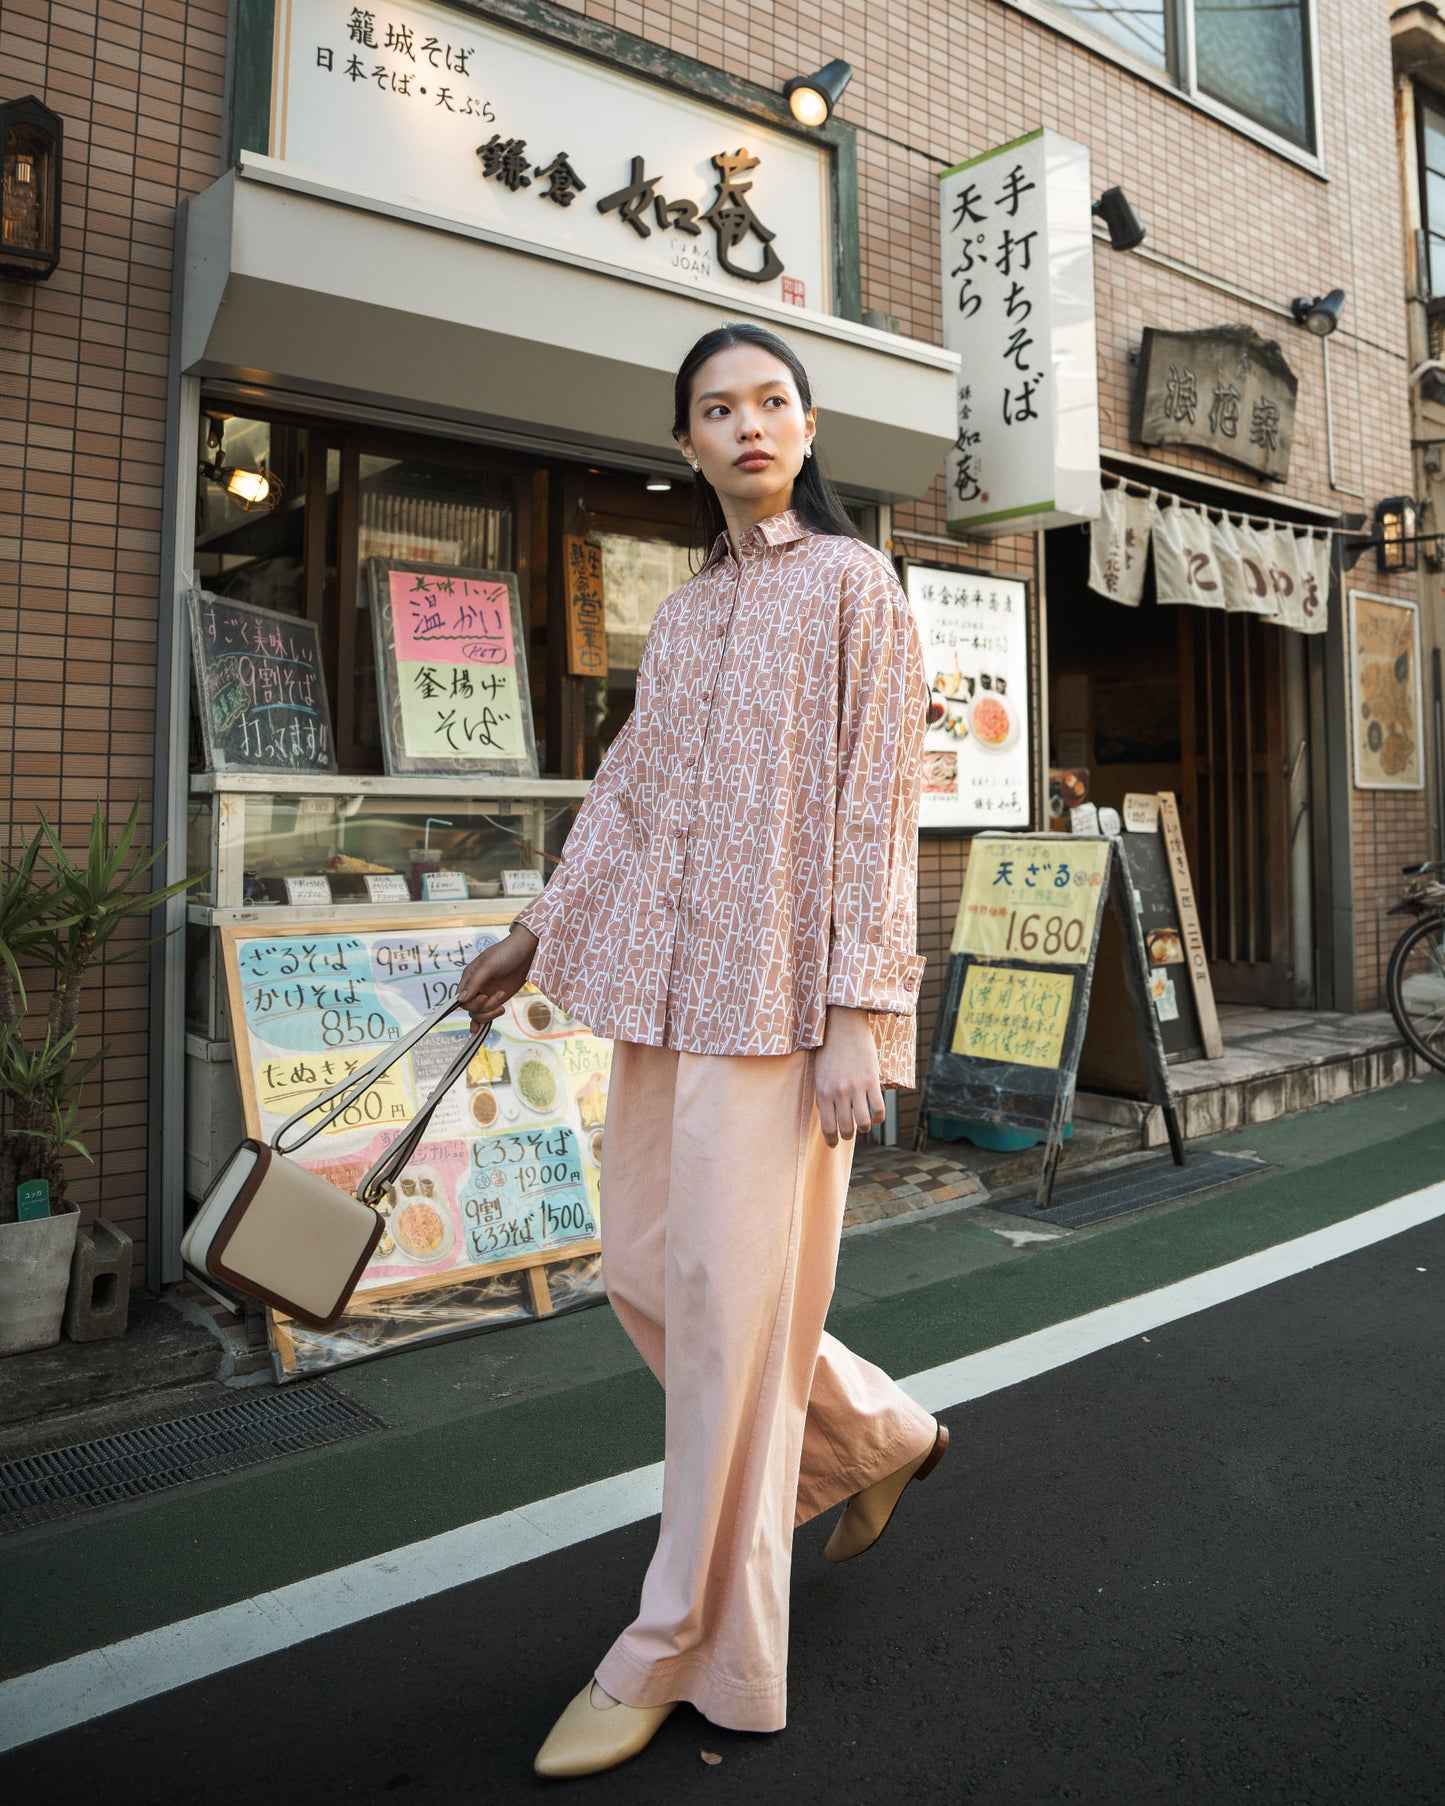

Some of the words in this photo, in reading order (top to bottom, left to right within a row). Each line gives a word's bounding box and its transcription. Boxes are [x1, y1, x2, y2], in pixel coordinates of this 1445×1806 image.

[347, 7, 475, 78] 籠城そば
[316, 46, 496, 123] 日本そば・天ぷら
[477, 134, 586, 208] 鎌倉
[671, 255, 711, 277] JOAN
[951, 184, 989, 319] 天ぷら
[994, 165, 1044, 426] 手打ちそば
[409, 595, 503, 634] 温かい
[573, 591, 604, 672] 営業中
[203, 608, 313, 662] すごく美味しい
[468, 646, 500, 659] HOT
[239, 656, 316, 706] 9割そば
[414, 667, 506, 701] 釜揚げ
[434, 707, 511, 751] そば
[992, 861, 1071, 888] 天ざる
[248, 941, 360, 976] ざるそば
[376, 941, 473, 976] 9割そば
[254, 977, 367, 1012] かけそば
[321, 1010, 401, 1047] 850円
[561, 1039, 592, 1058] 人気
[263, 1060, 391, 1089] たぬきそ
[473, 1129, 574, 1168] とろろそば
[24, 1189, 43, 1200] ユッカ
[465, 1197, 503, 1225] 9割
[471, 1213, 535, 1254] とろろそば
